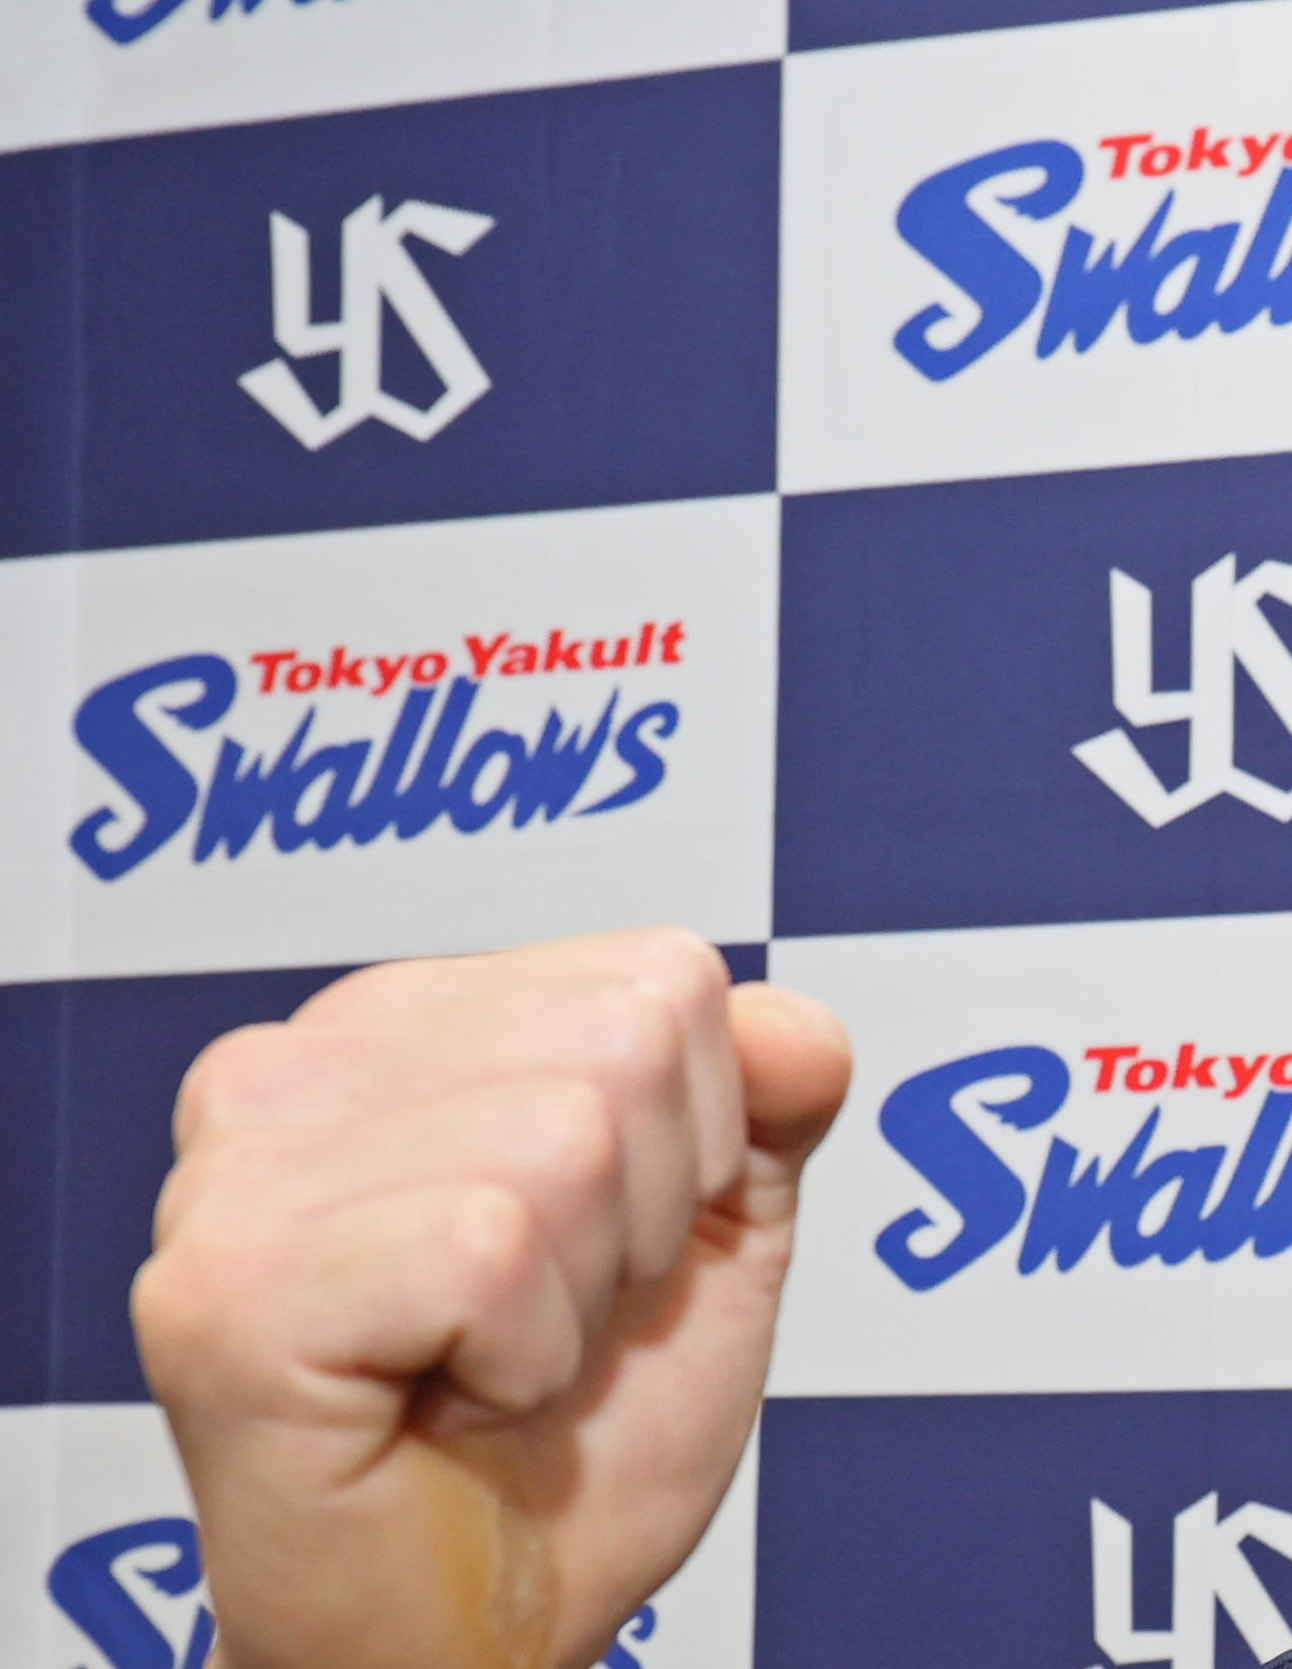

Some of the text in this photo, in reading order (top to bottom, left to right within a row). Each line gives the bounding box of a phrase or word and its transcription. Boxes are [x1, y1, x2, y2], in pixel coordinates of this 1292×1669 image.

[250, 621, 685, 697] Tokyo Yakult
[69, 653, 680, 882] Swallows
